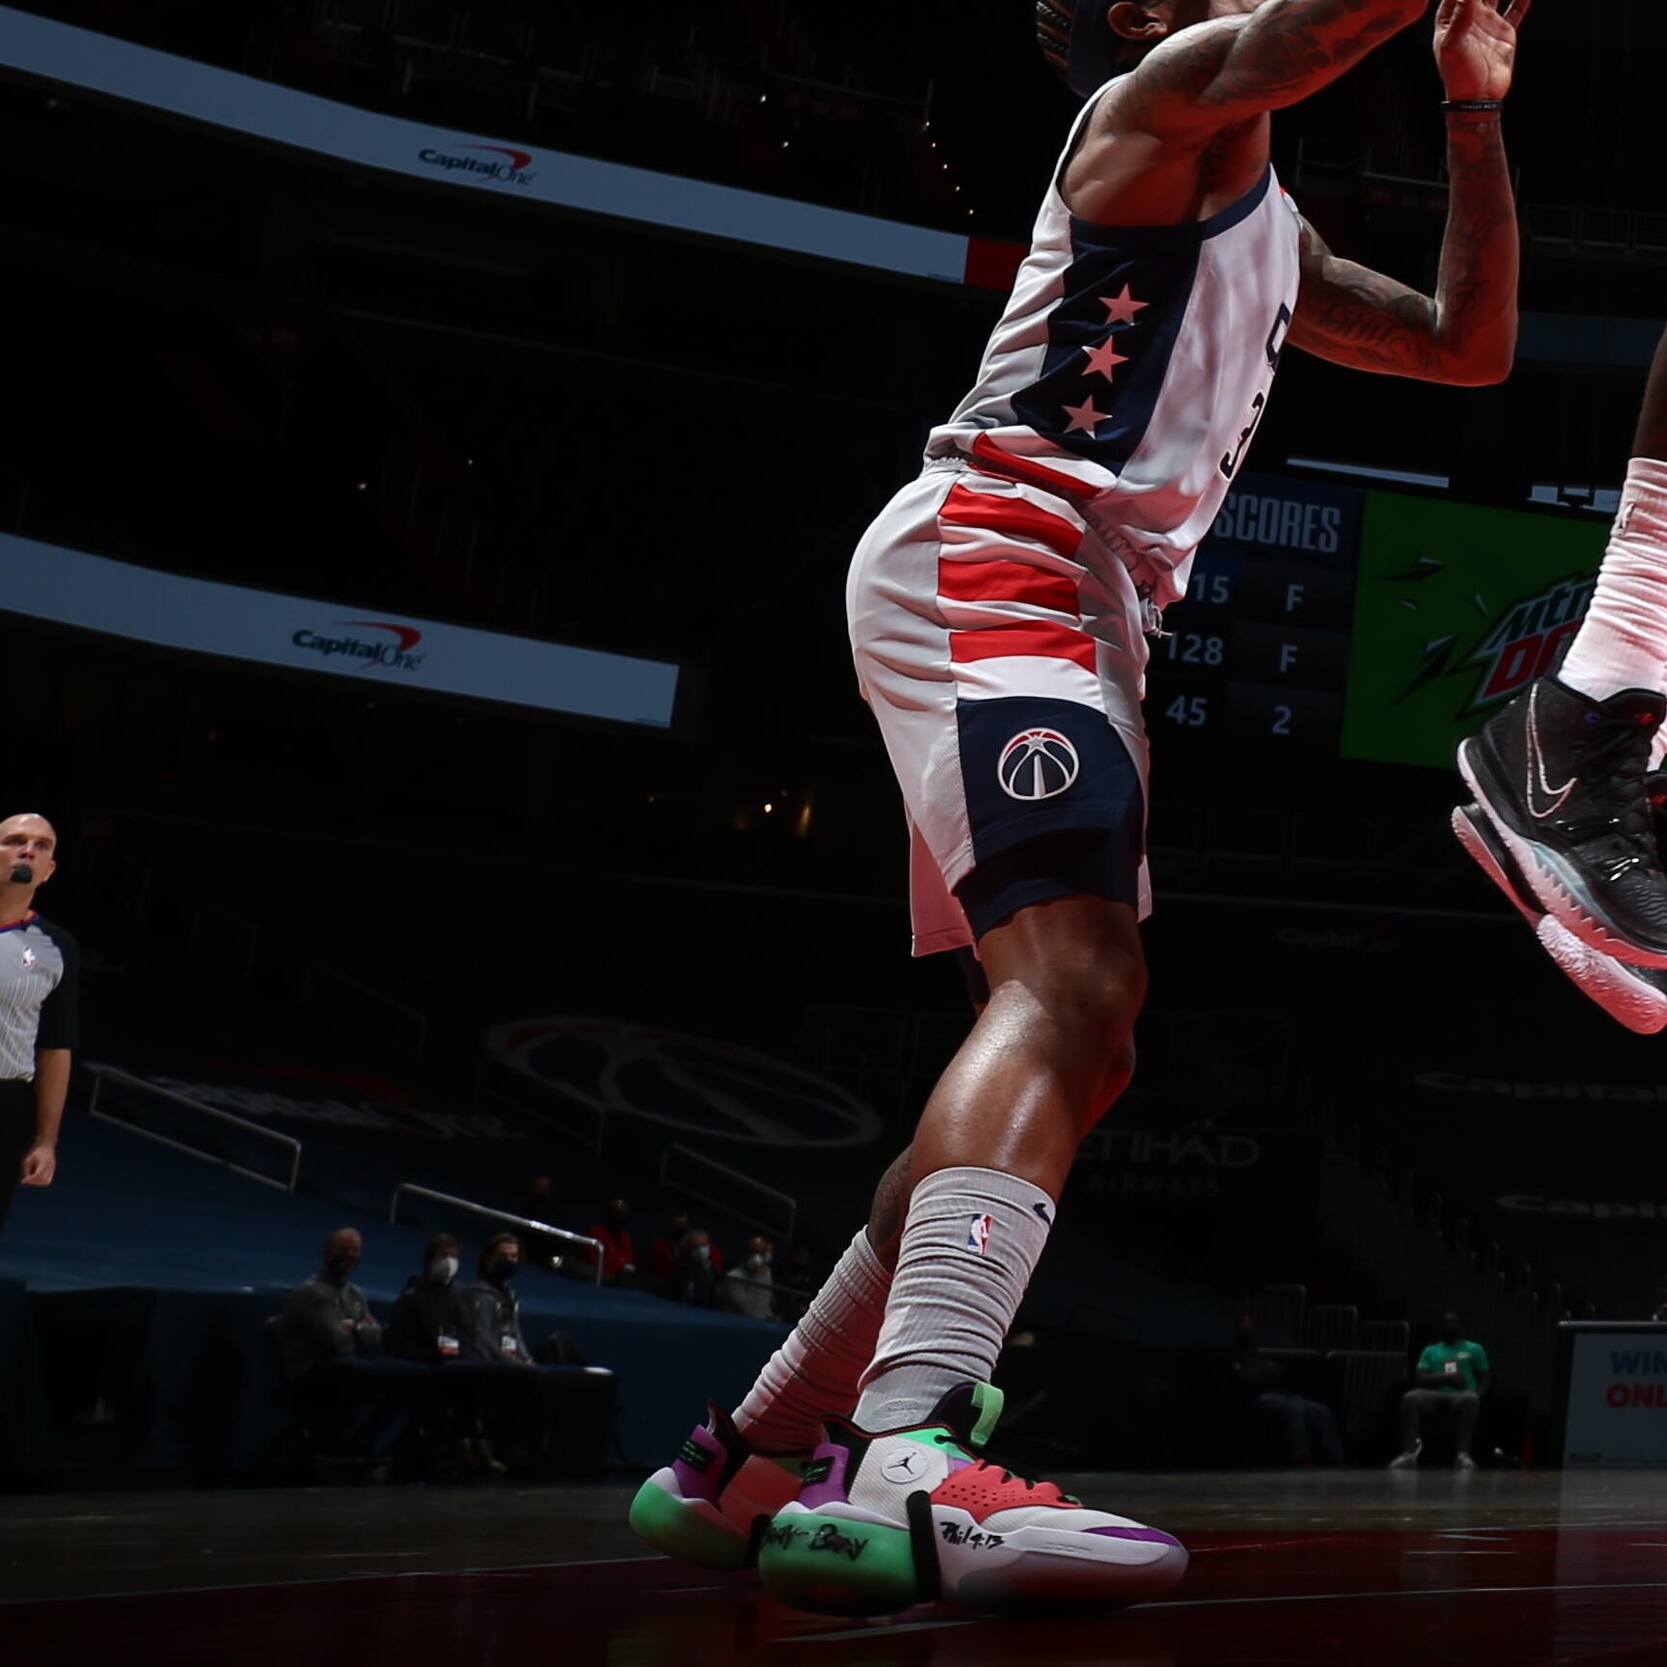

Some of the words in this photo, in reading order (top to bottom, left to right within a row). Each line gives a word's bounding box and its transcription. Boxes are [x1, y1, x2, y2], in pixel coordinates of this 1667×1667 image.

[1216, 493, 1341, 554] SCORES
[1286, 582, 1305, 614] F
[1166, 630, 1224, 666] 128
[1280, 644, 1299, 673] F
[1165, 694, 1209, 728] 45
[1272, 704, 1293, 735] 2
